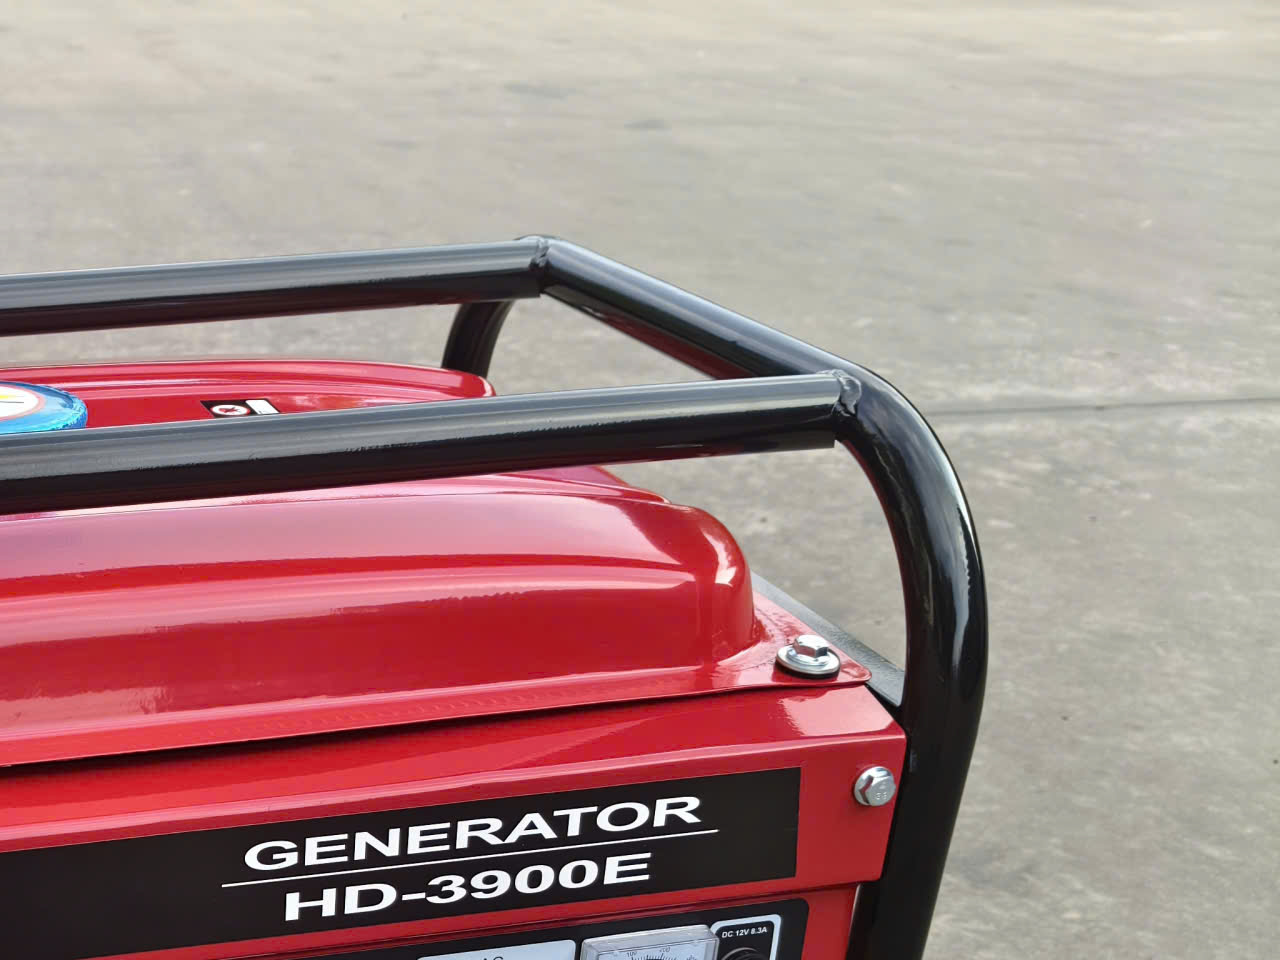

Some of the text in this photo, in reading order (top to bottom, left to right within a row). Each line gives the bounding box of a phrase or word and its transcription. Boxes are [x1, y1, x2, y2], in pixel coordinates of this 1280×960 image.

[243, 796, 702, 871] GENERATOR
[284, 853, 652, 921] HD-3900E
[721, 930, 733, 938] DC
[735, 928, 749, 936] 12V
